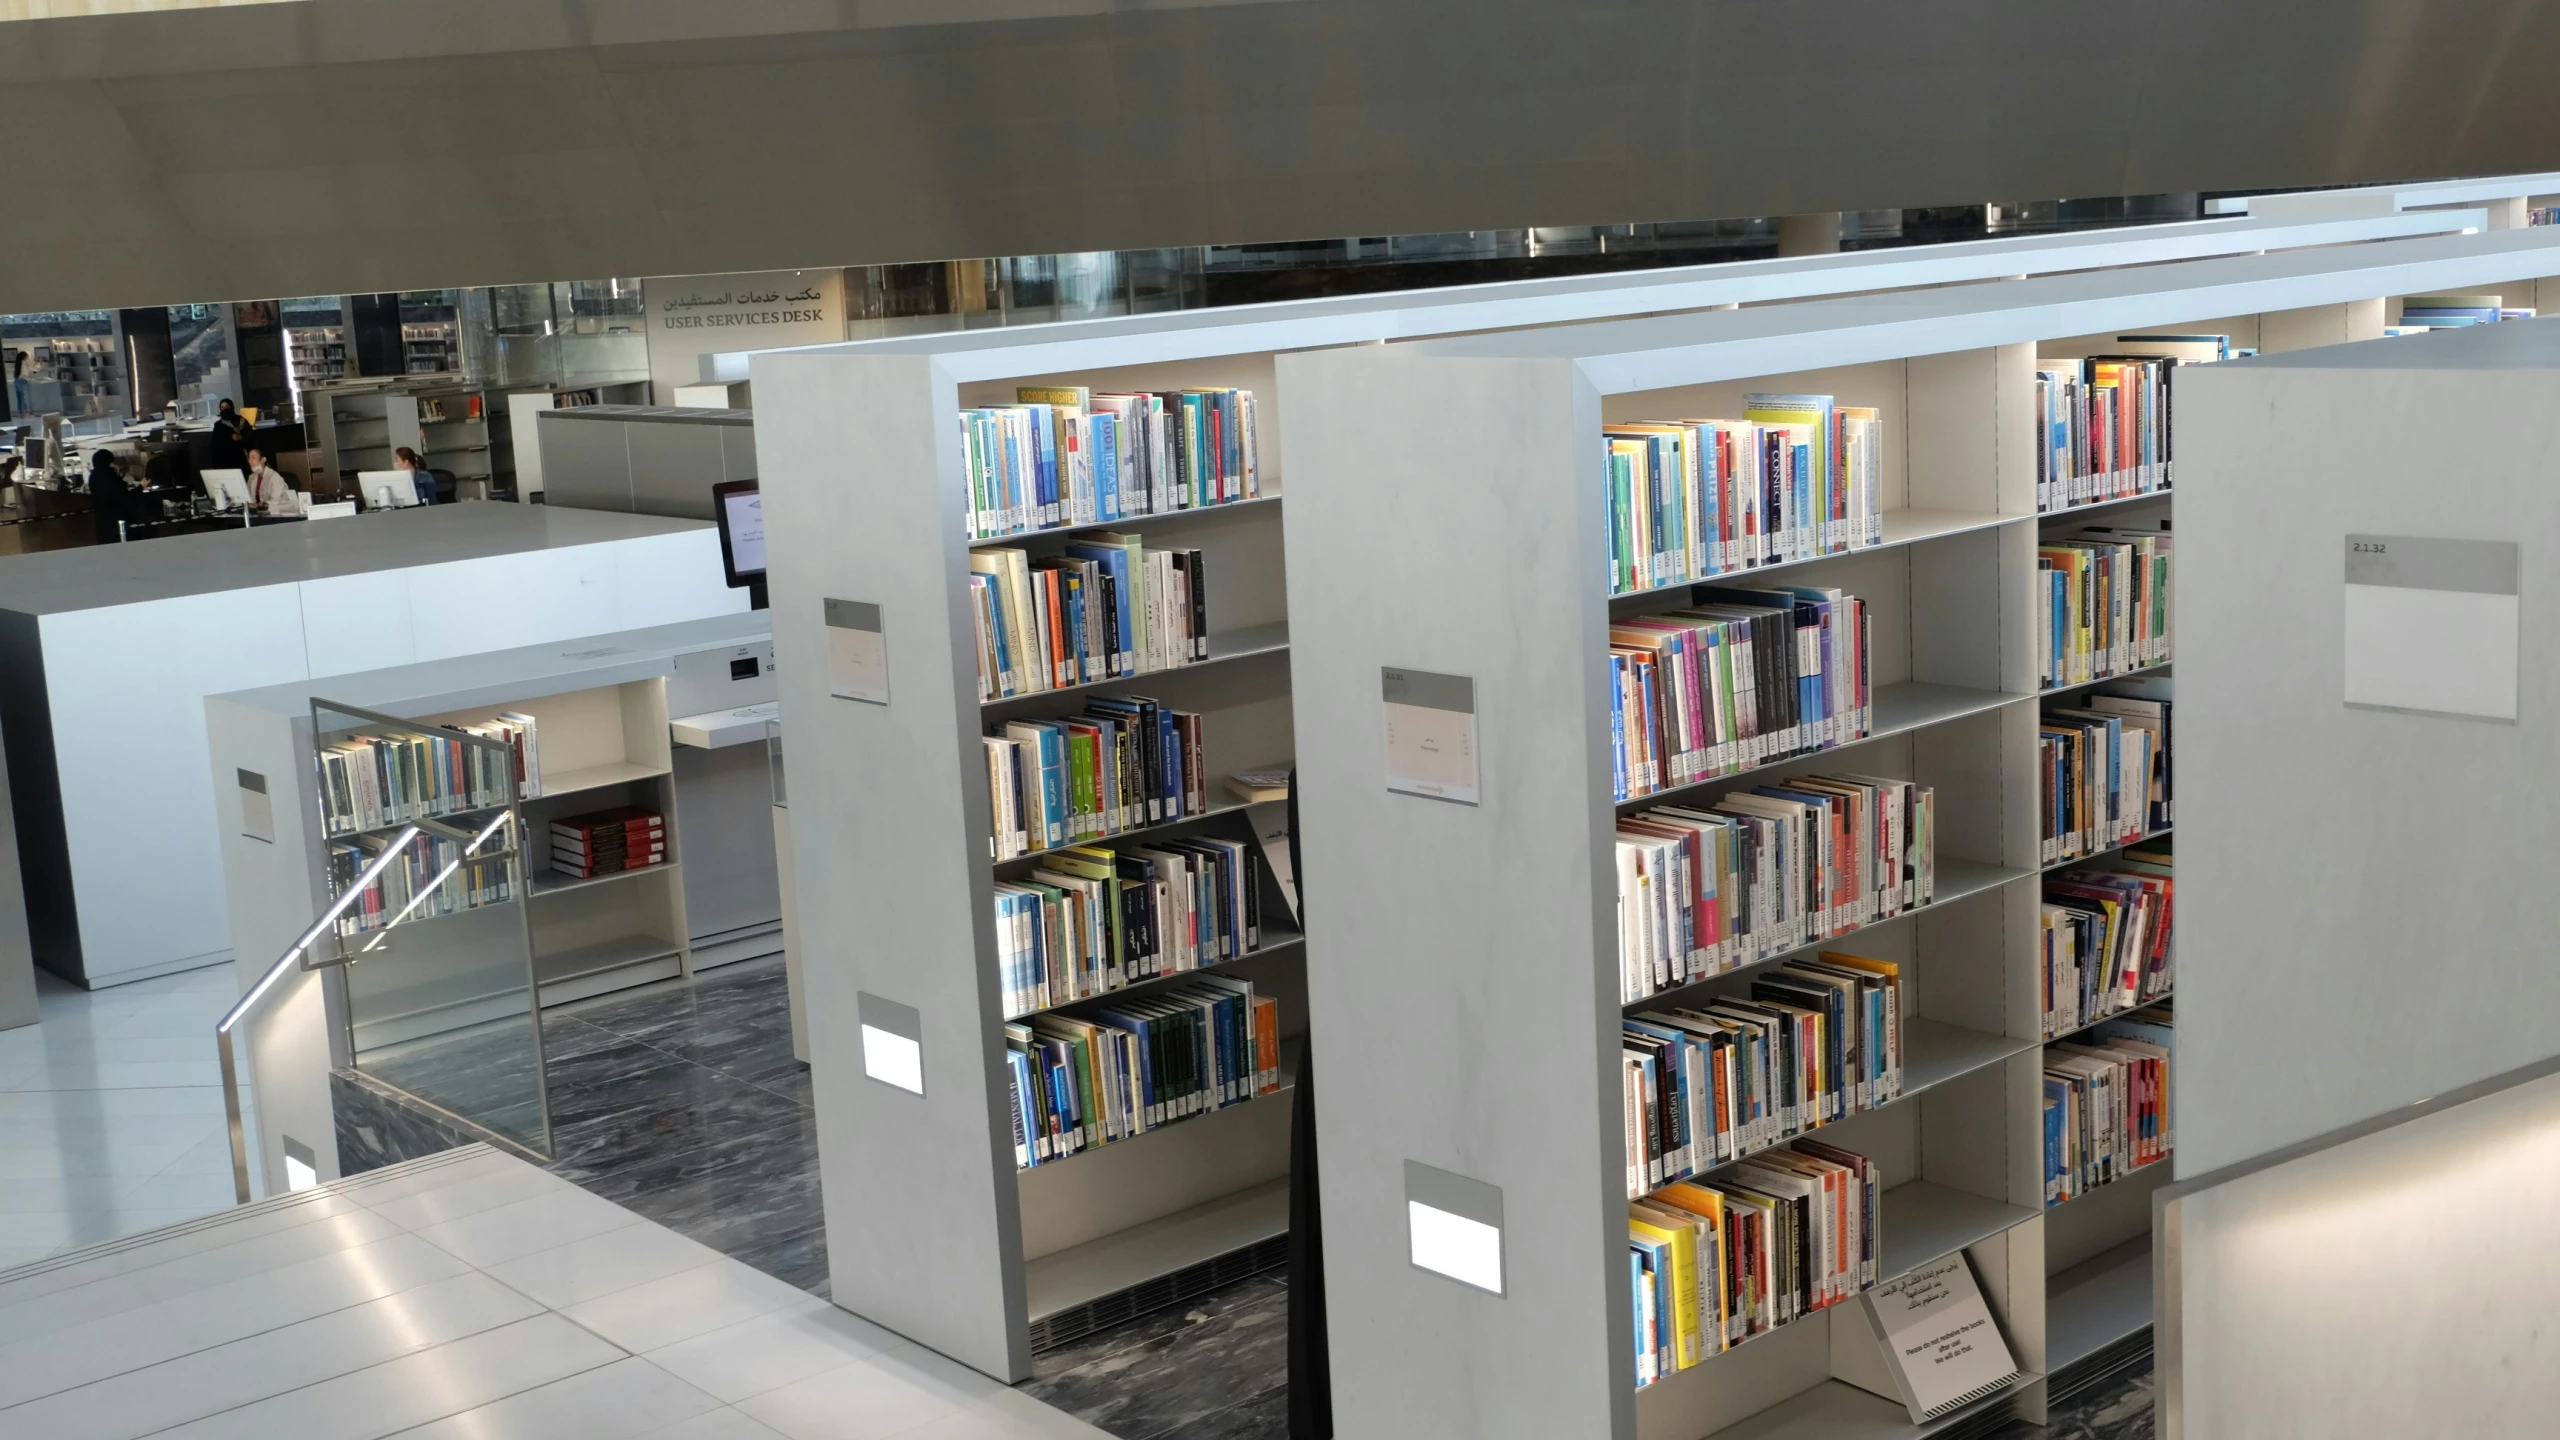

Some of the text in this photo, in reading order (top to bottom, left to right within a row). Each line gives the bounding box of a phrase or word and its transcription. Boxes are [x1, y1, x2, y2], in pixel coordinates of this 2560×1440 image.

[663, 288, 821, 311] مكتب خدمات المستفيدين
[665, 309, 823, 329] USER SERVICES DESK
[1021, 389, 1078, 404] SCORE HIGHER
[1103, 419, 1115, 493] 1001 IDEAS
[1708, 460, 1717, 504] PRIZE
[1772, 450, 1781, 509] CONNECT
[2353, 542, 2386, 554] 2.1.32
[1009, 630, 1019, 656] MIND
[1027, 627, 1037, 653] MIND
[1108, 746, 1116, 769] Aspects
[1010, 1091, 1025, 1128] MENTAL
[1648, 1102, 1657, 1136] Forgiving
[1669, 1091, 1680, 1143] Forgiveness
[1627, 1099, 1635, 1147] FORGIVENESS
[1905, 1319, 1986, 1356] Please do not reshelve the books
[1938, 1344, 1951, 1353] after
[1934, 1357, 1944, 1365] We
[1944, 1352, 1954, 1361] will
